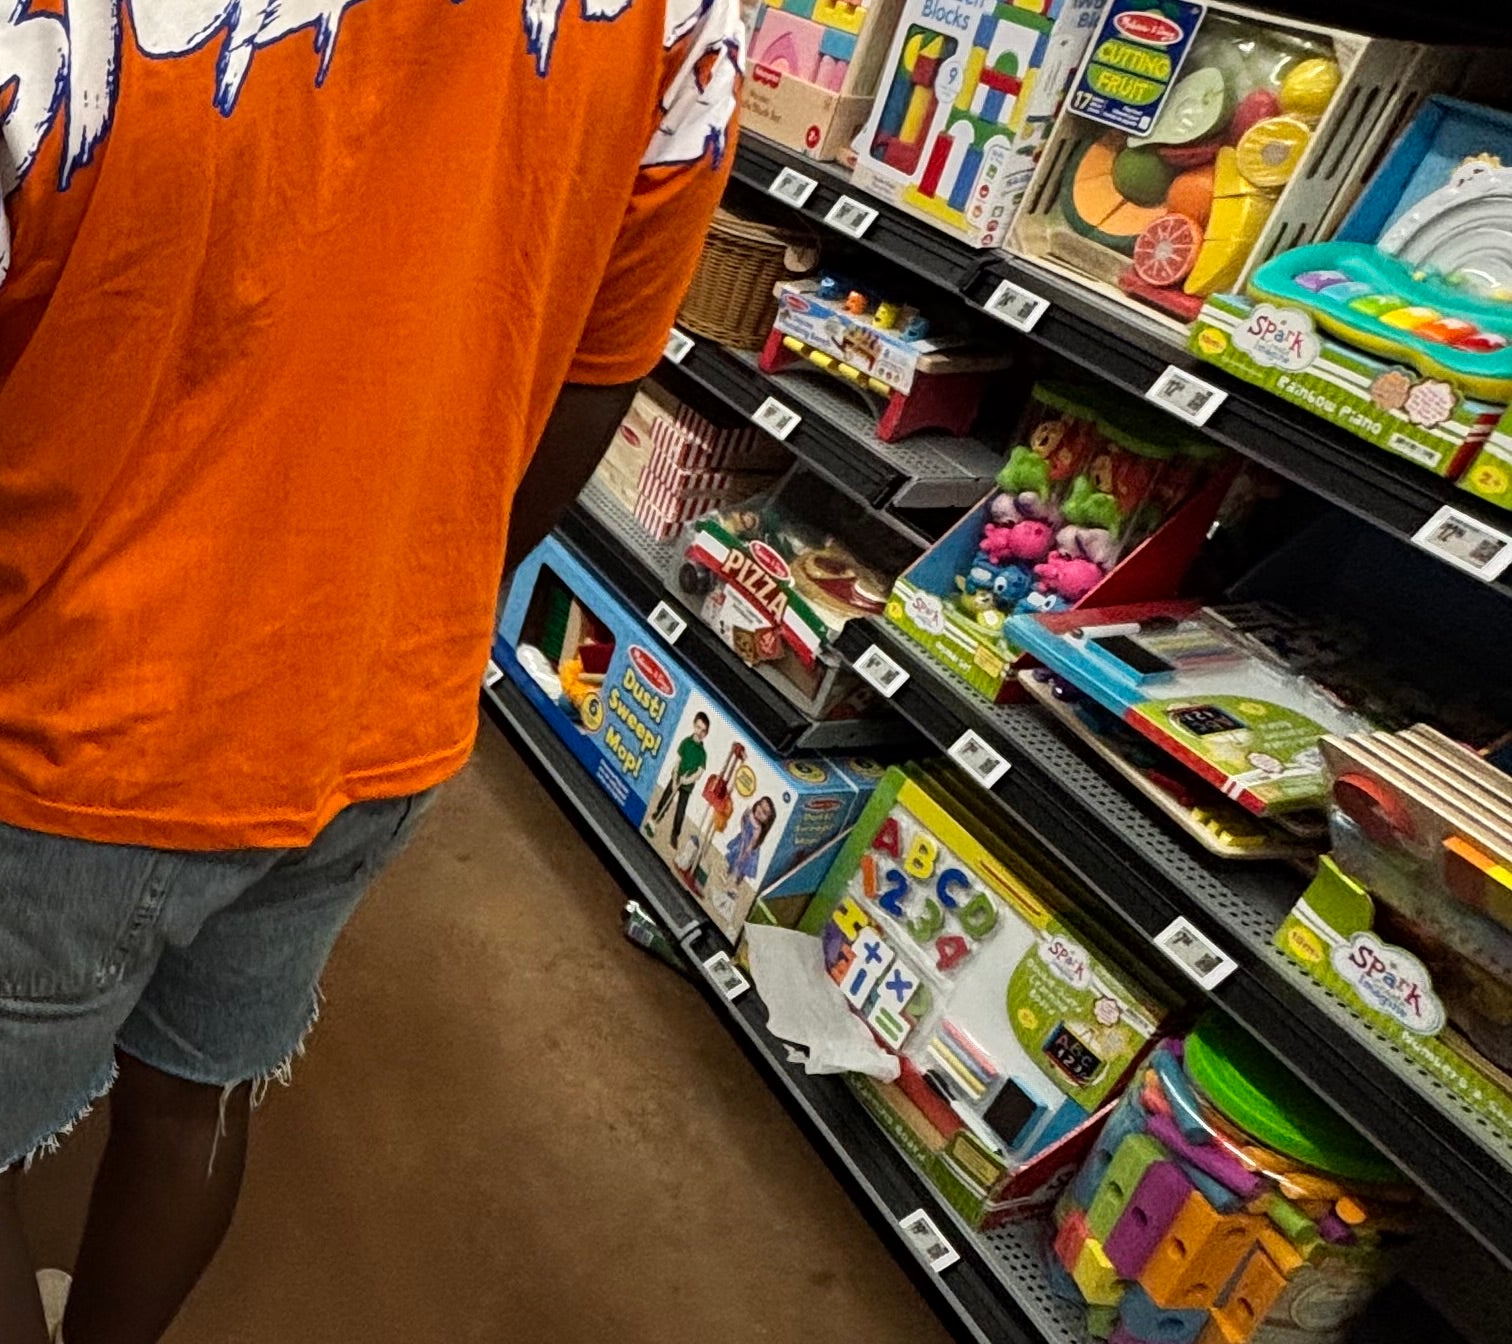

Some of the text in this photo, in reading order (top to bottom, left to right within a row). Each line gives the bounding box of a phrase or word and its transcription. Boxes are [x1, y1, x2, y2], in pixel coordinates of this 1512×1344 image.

[948, 67, 958, 85] 9
[1096, 71, 1148, 100] FRUIT
[1097, 44, 1170, 80] CUTTING
[1074, 90, 1092, 110] 17
[1276, 374, 1383, 436] Rainbow Piano
[721, 547, 788, 625] PIZZA
[622, 667, 666, 724] Dust!
[608, 688, 662, 758] Sweep!
[604, 726, 643, 778] Mop!
[879, 868, 909, 918] 2
[904, 832, 938, 879] B
[936, 868, 970, 909] C
[960, 892, 999, 937] D
